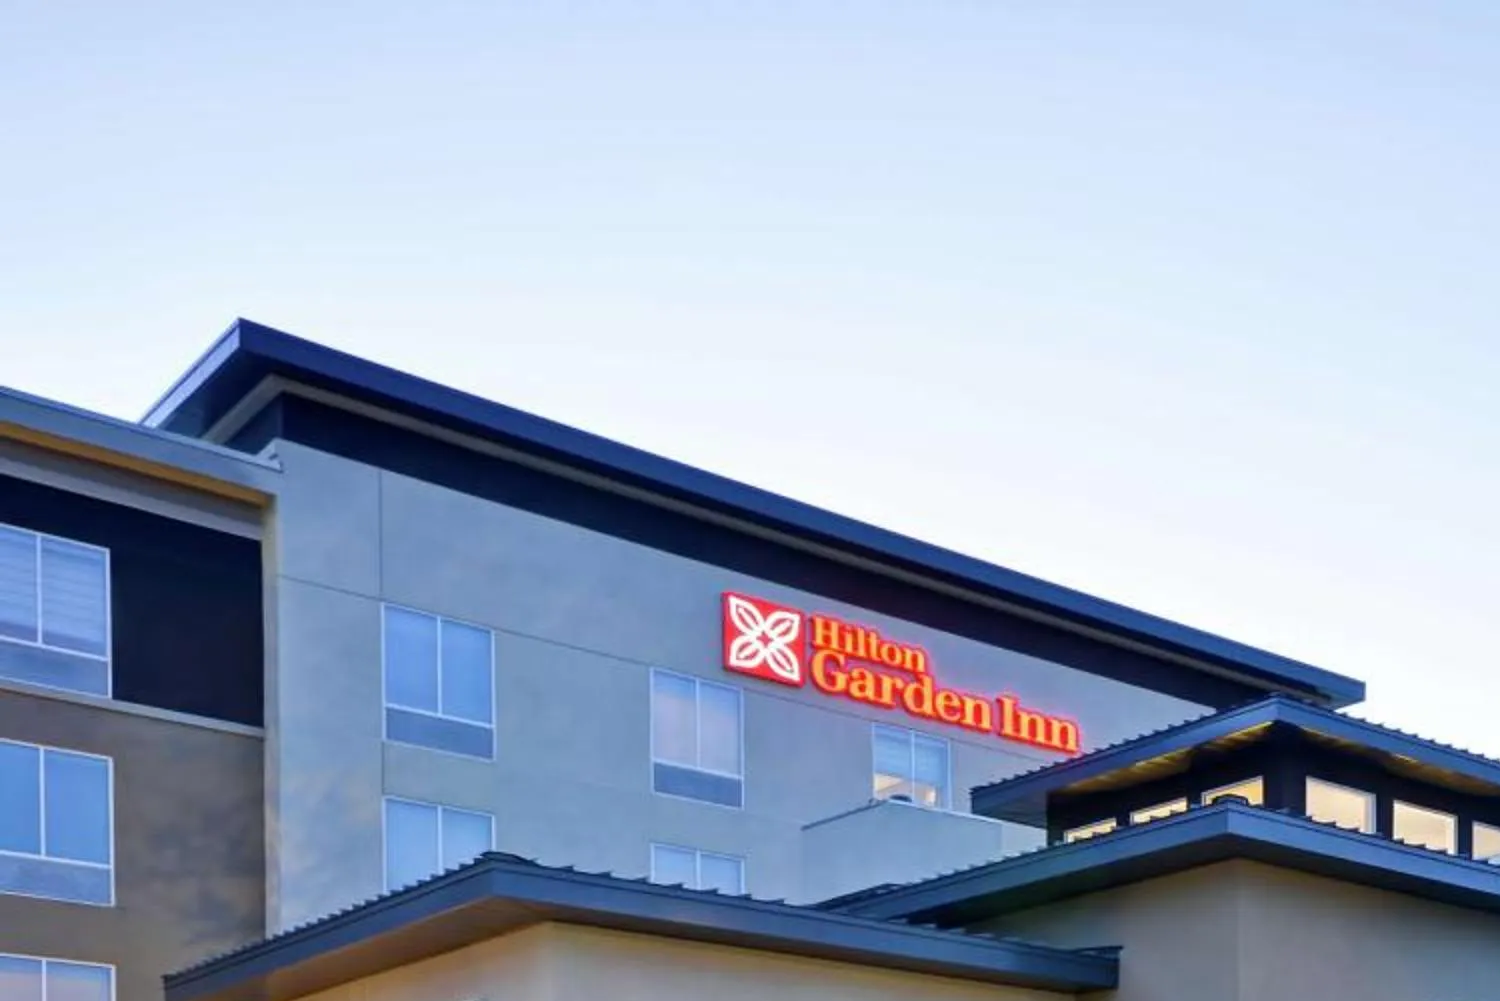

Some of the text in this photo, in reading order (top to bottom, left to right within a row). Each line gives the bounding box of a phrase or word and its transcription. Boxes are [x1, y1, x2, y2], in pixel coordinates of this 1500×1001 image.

[811, 615, 926, 673] Hilton
[811, 649, 1079, 752] Garden Inn
